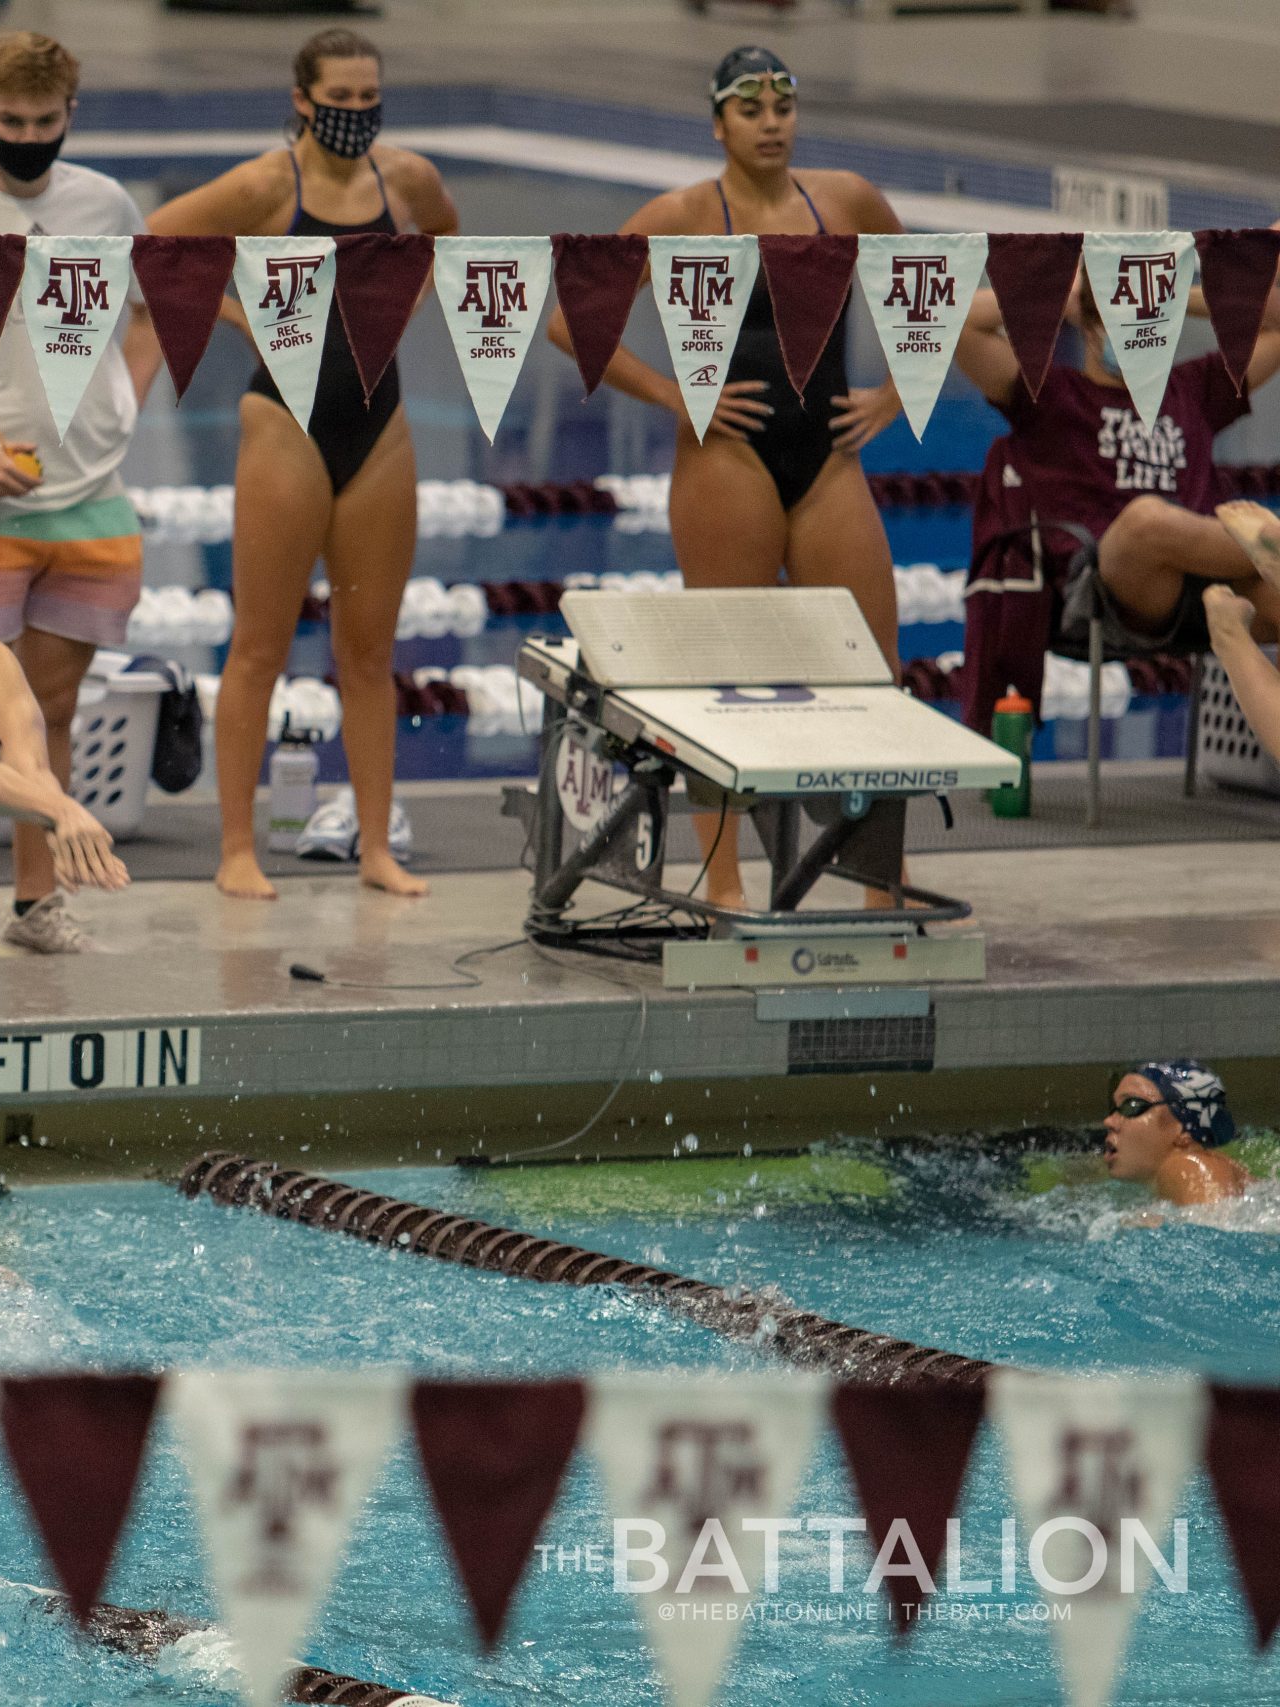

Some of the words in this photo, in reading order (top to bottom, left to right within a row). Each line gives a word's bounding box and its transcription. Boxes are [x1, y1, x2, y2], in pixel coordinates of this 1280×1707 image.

[276, 323, 300, 338] REC
[692, 330, 714, 340] REC
[907, 331, 931, 341] REC
[1135, 326, 1158, 338] REC
[58, 333, 85, 344] REC
[270, 333, 313, 352] SPORTS
[481, 336, 505, 346] REC
[1124, 336, 1167, 351] SPORTS
[46, 343, 93, 357] SPORTS
[470, 346, 516, 359] SPORTS
[681, 341, 724, 352] SPORTS
[896, 342, 942, 353] SPORTS
[796, 769, 959, 790] DAKTRONICS
[636, 811, 653, 871] 5
[70, 1032, 106, 1089] 0
[136, 1028, 189, 1088] IN
